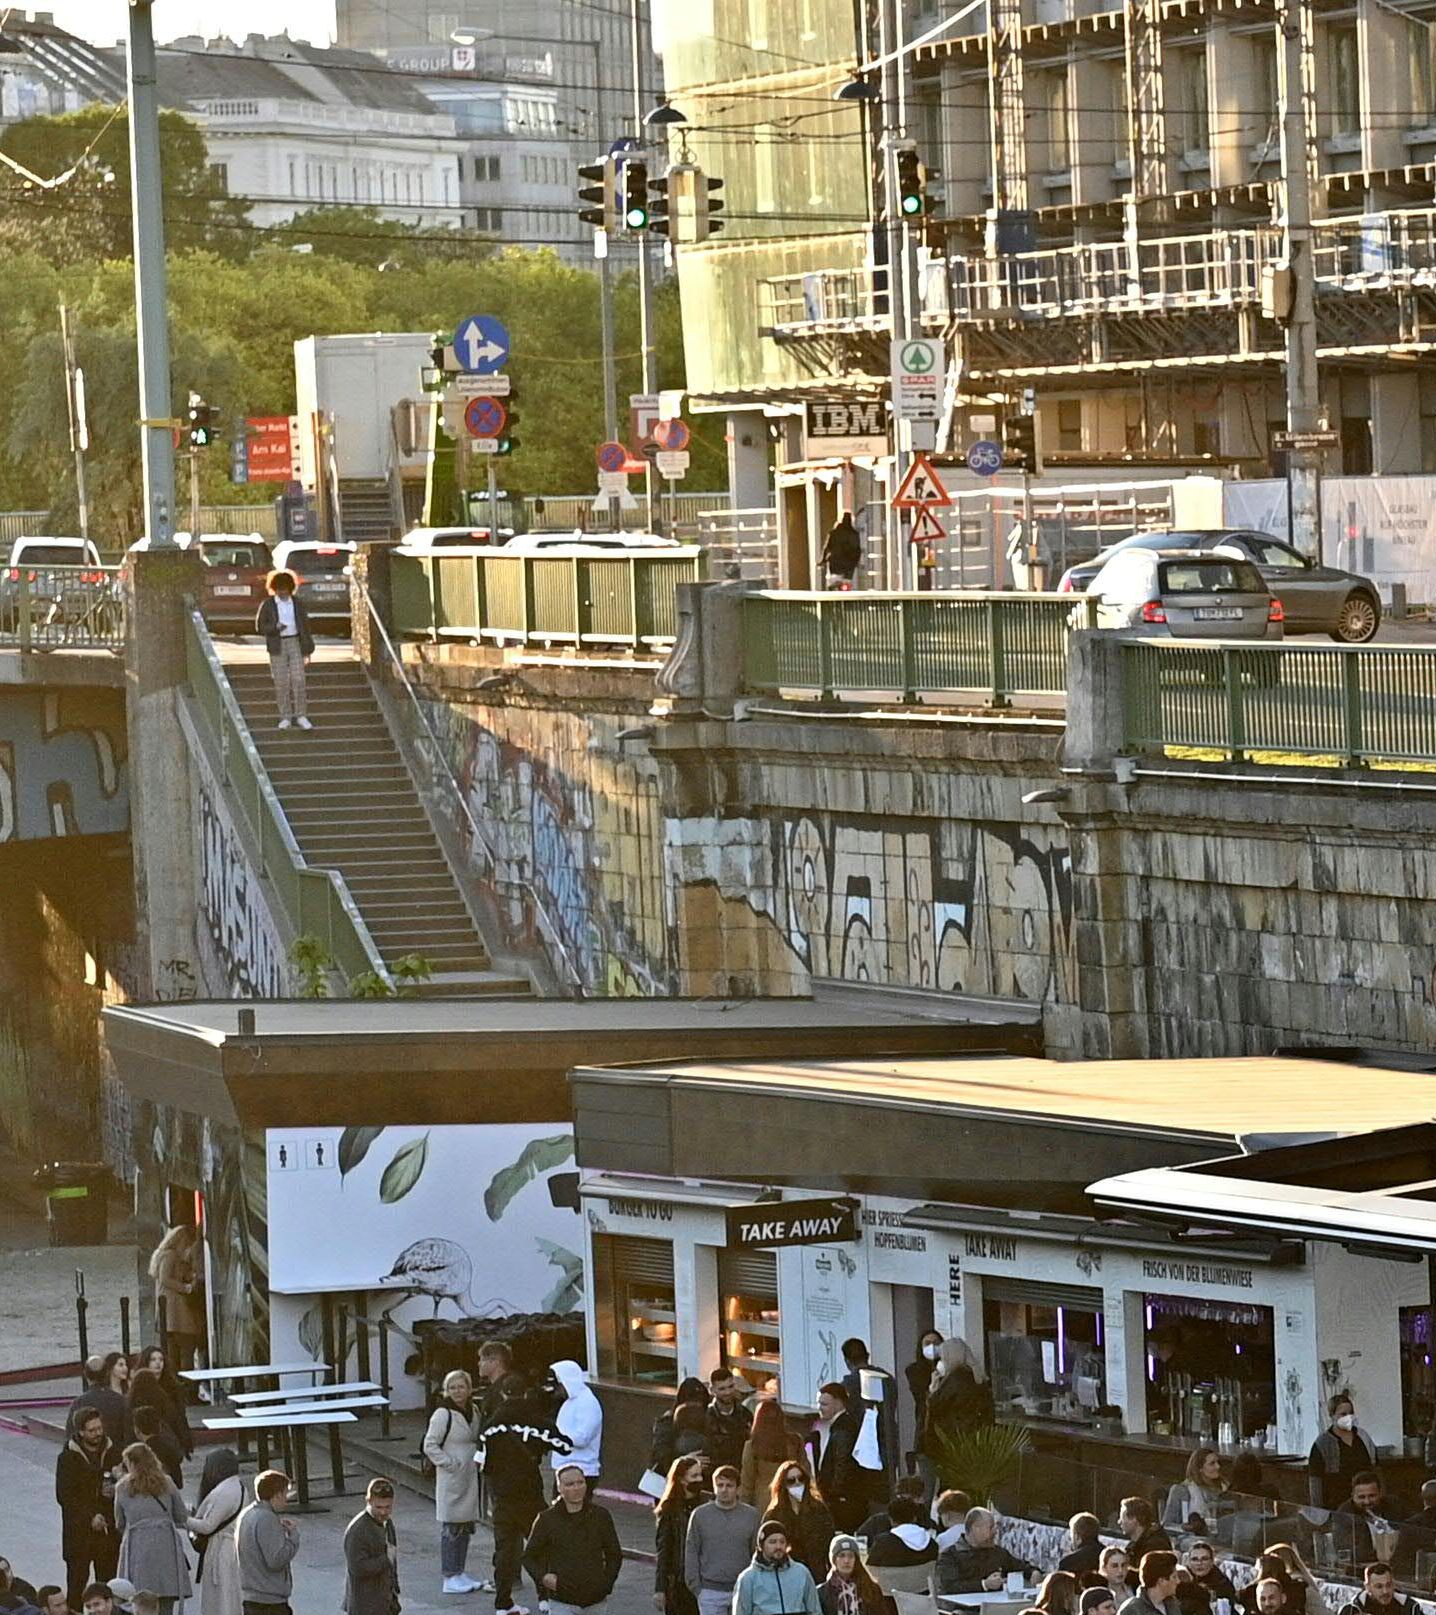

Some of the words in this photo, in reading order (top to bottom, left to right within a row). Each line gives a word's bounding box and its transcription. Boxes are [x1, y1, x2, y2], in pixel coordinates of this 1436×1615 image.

[812, 404, 880, 435] IBM
[659, 1202, 673, 1221] GO
[861, 1209, 877, 1225] HIER
[740, 1220, 786, 1242] TAKE
[789, 1215, 843, 1238] AWAY
[874, 1231, 927, 1252] HOPFENBLUMEN
[964, 1234, 987, 1258] TAKE
[989, 1236, 1017, 1261] AWAY
[949, 1254, 962, 1306] HERE
[1142, 1260, 1167, 1279] FRISCH
[1168, 1263, 1185, 1281] VON
[1186, 1265, 1201, 1283] DER
[1201, 1266, 1253, 1289] BLUMENWIESE
